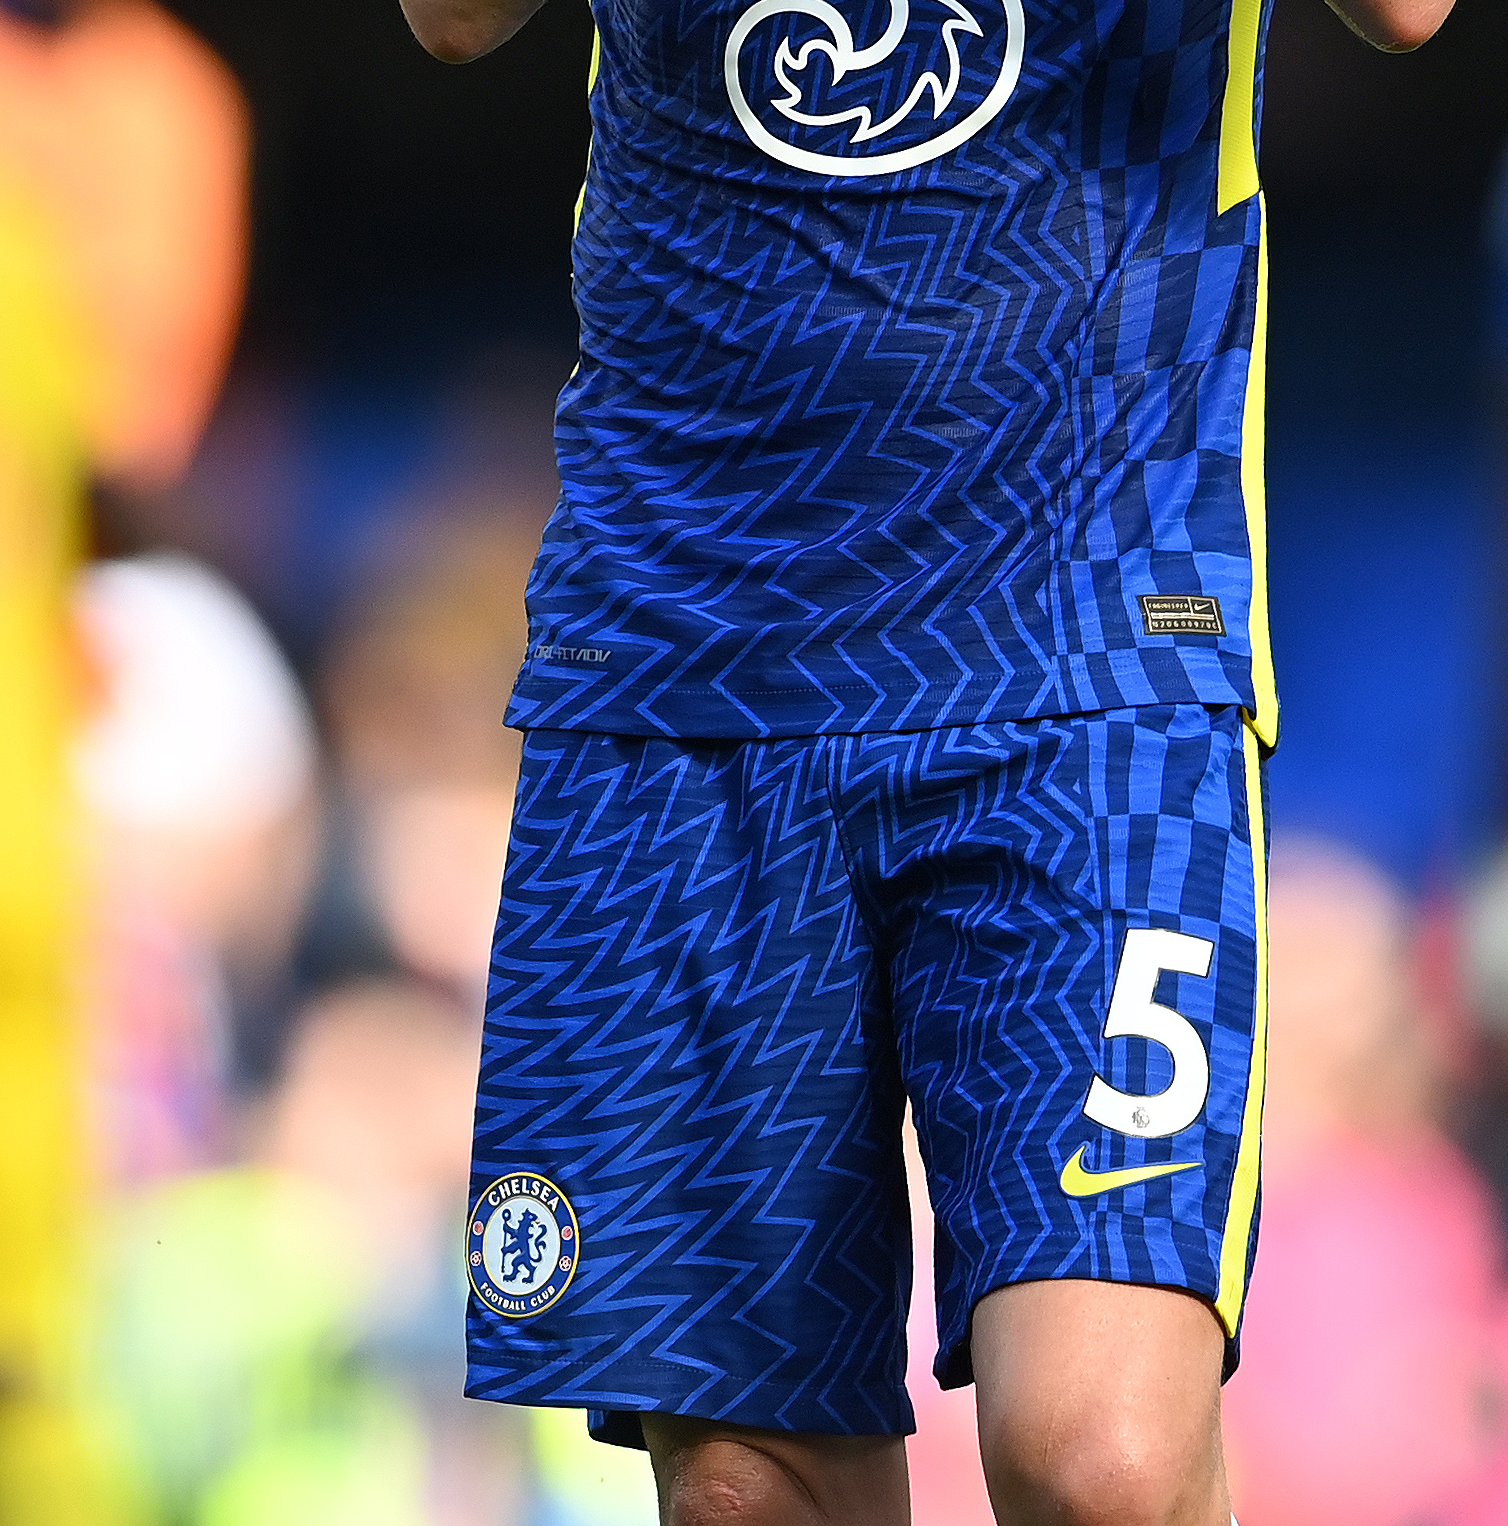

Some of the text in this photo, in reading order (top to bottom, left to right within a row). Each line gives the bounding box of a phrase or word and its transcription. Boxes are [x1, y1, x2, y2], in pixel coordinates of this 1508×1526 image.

[1082, 928, 1215, 1139] 5
[488, 1178, 560, 1212] CHELSEA
[480, 1282, 556, 1311] FOOTBALL CLUB
